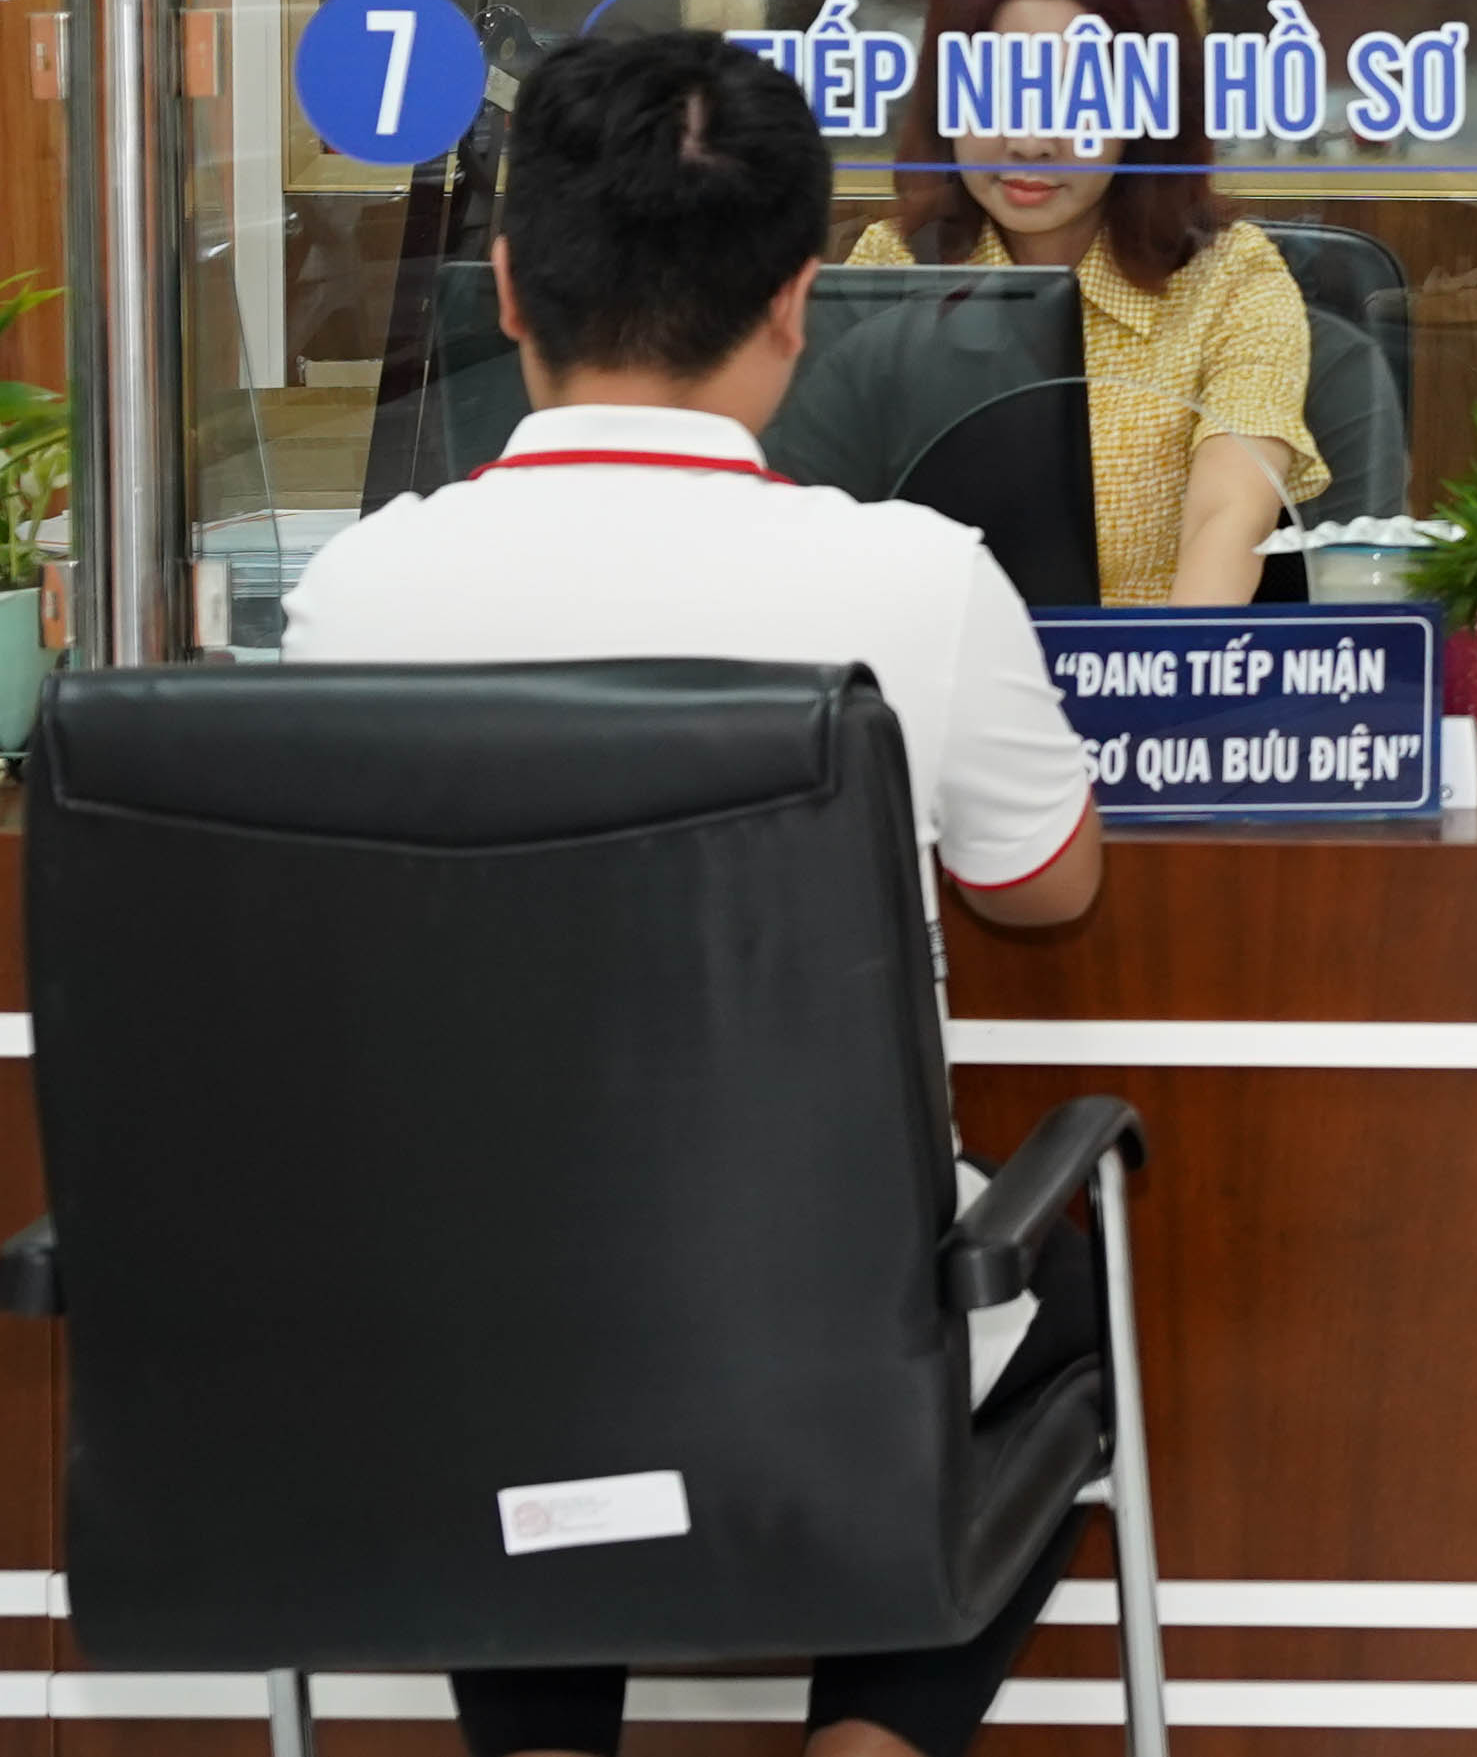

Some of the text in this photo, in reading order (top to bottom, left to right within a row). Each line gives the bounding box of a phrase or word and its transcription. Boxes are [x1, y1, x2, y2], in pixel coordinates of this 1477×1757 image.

[365, 10, 418, 137] 7
[938, 14, 1180, 158] NHẬN
[1346, 22, 1470, 143] SƠ
[1185, 632, 1274, 696] TIẾP
[1282, 636, 1386, 704] NHẬN
[1085, 731, 1131, 786] SƠ
[1135, 736, 1212, 793] QUA
[1221, 728, 1300, 784] BƯU
